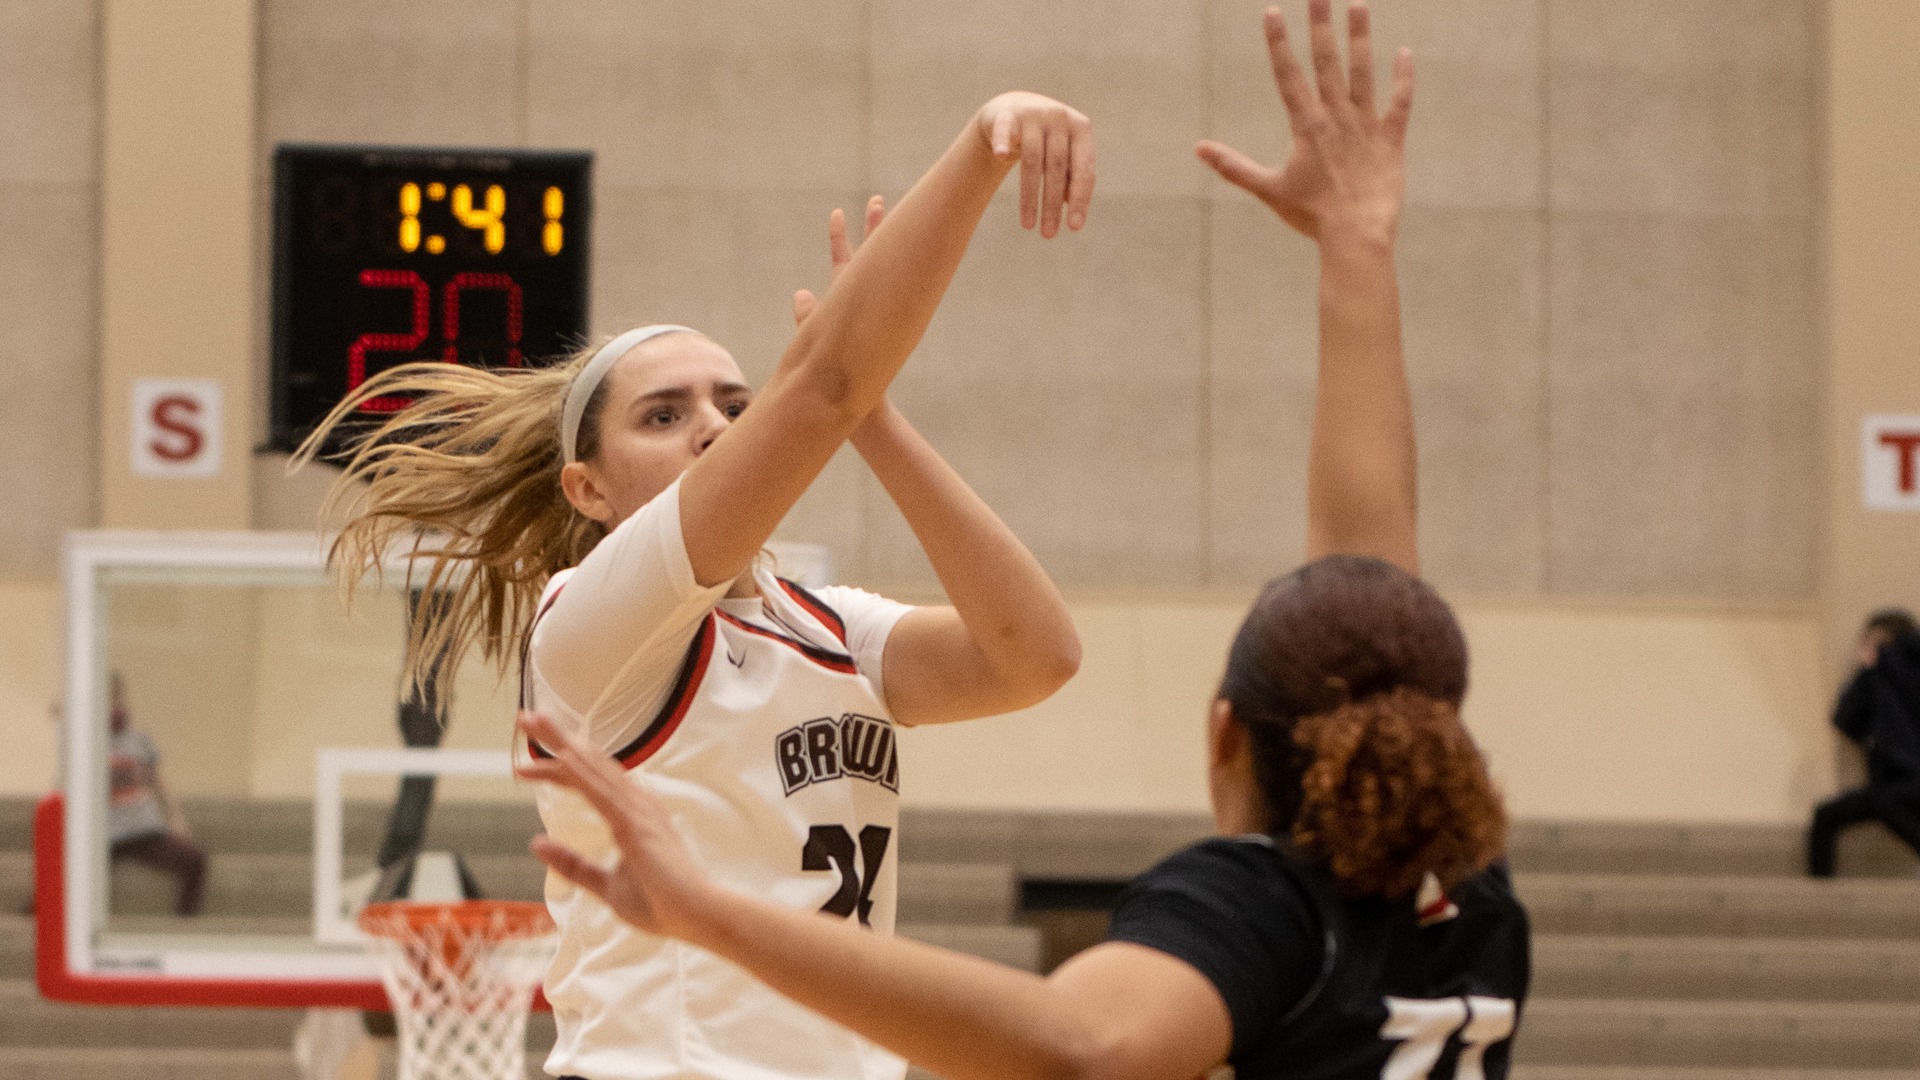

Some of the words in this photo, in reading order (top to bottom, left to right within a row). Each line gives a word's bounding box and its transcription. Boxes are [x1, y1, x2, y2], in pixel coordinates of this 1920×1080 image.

[400, 181, 563, 255] 1:41
[150, 394, 203, 463] S
[1878, 430, 1920, 494] T
